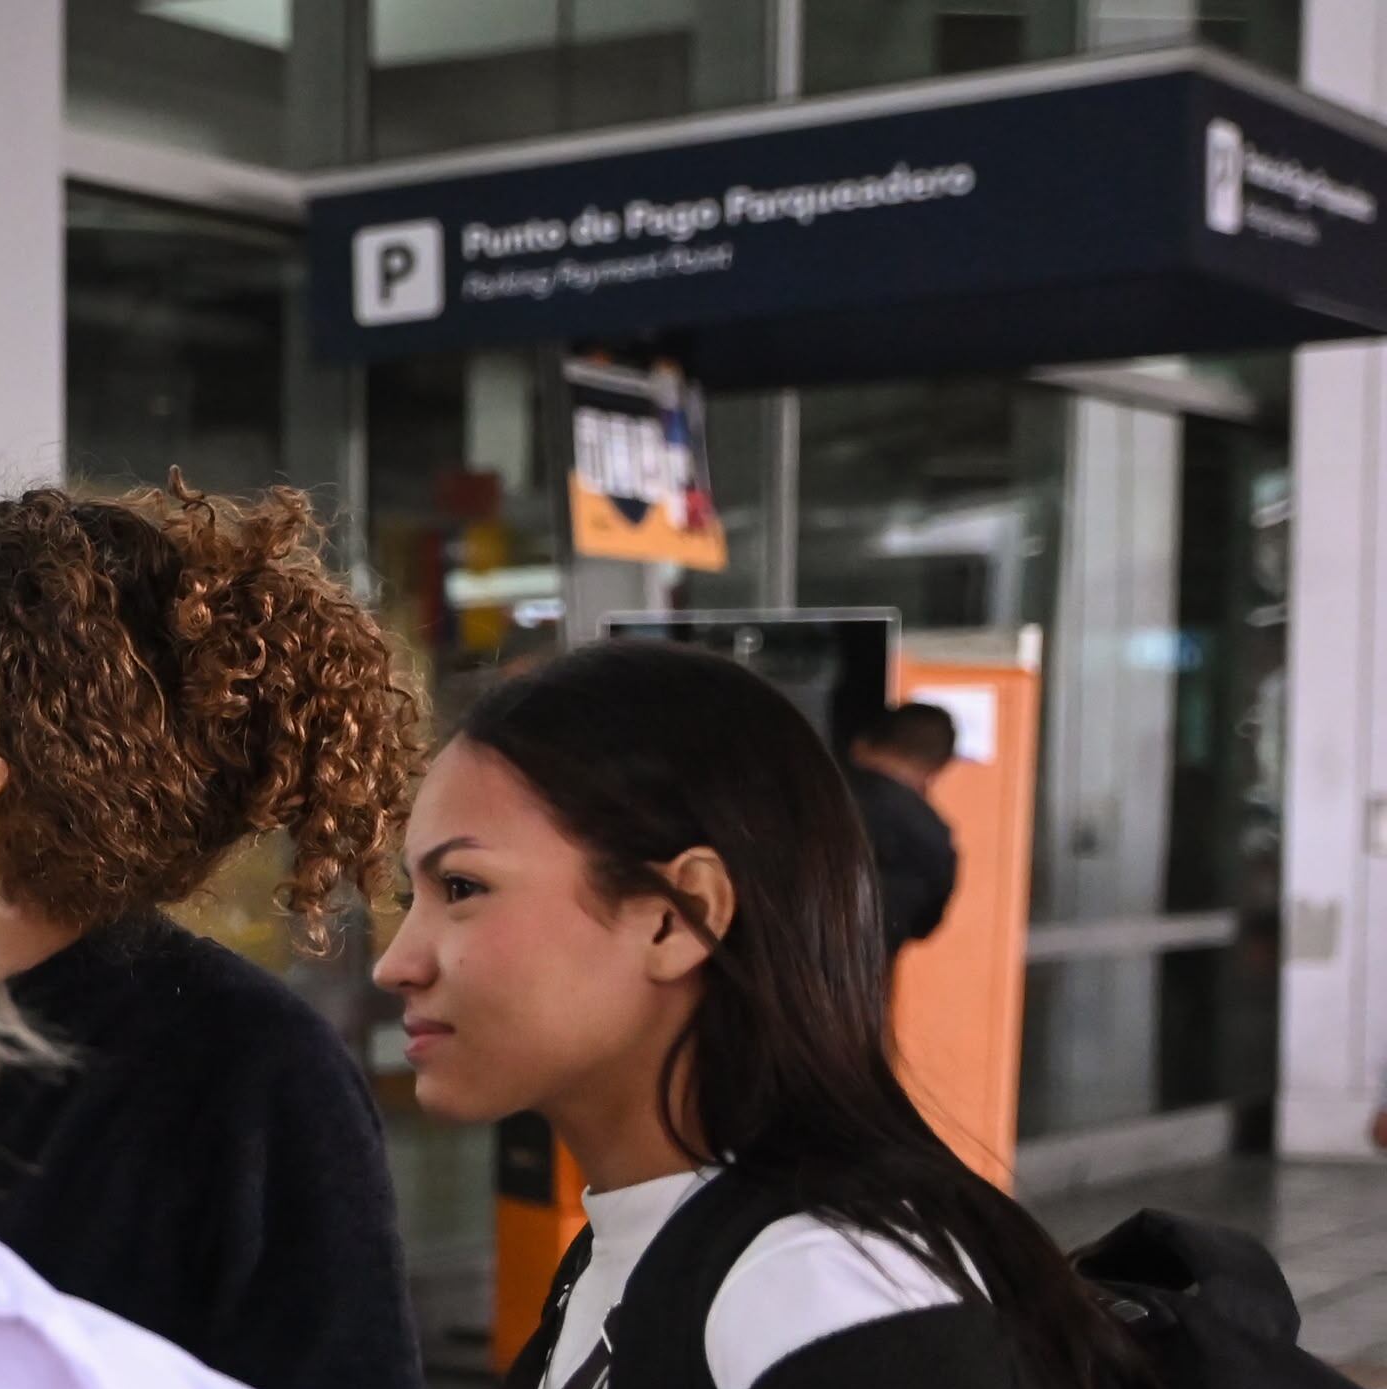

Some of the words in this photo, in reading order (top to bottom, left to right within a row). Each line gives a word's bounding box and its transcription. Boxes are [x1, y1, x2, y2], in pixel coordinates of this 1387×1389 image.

[461, 222, 567, 261] Punto
[571, 203, 621, 246] de
[624, 199, 722, 243] Pago
[724, 161, 976, 226] Parqueadero
[380, 243, 416, 305] P
